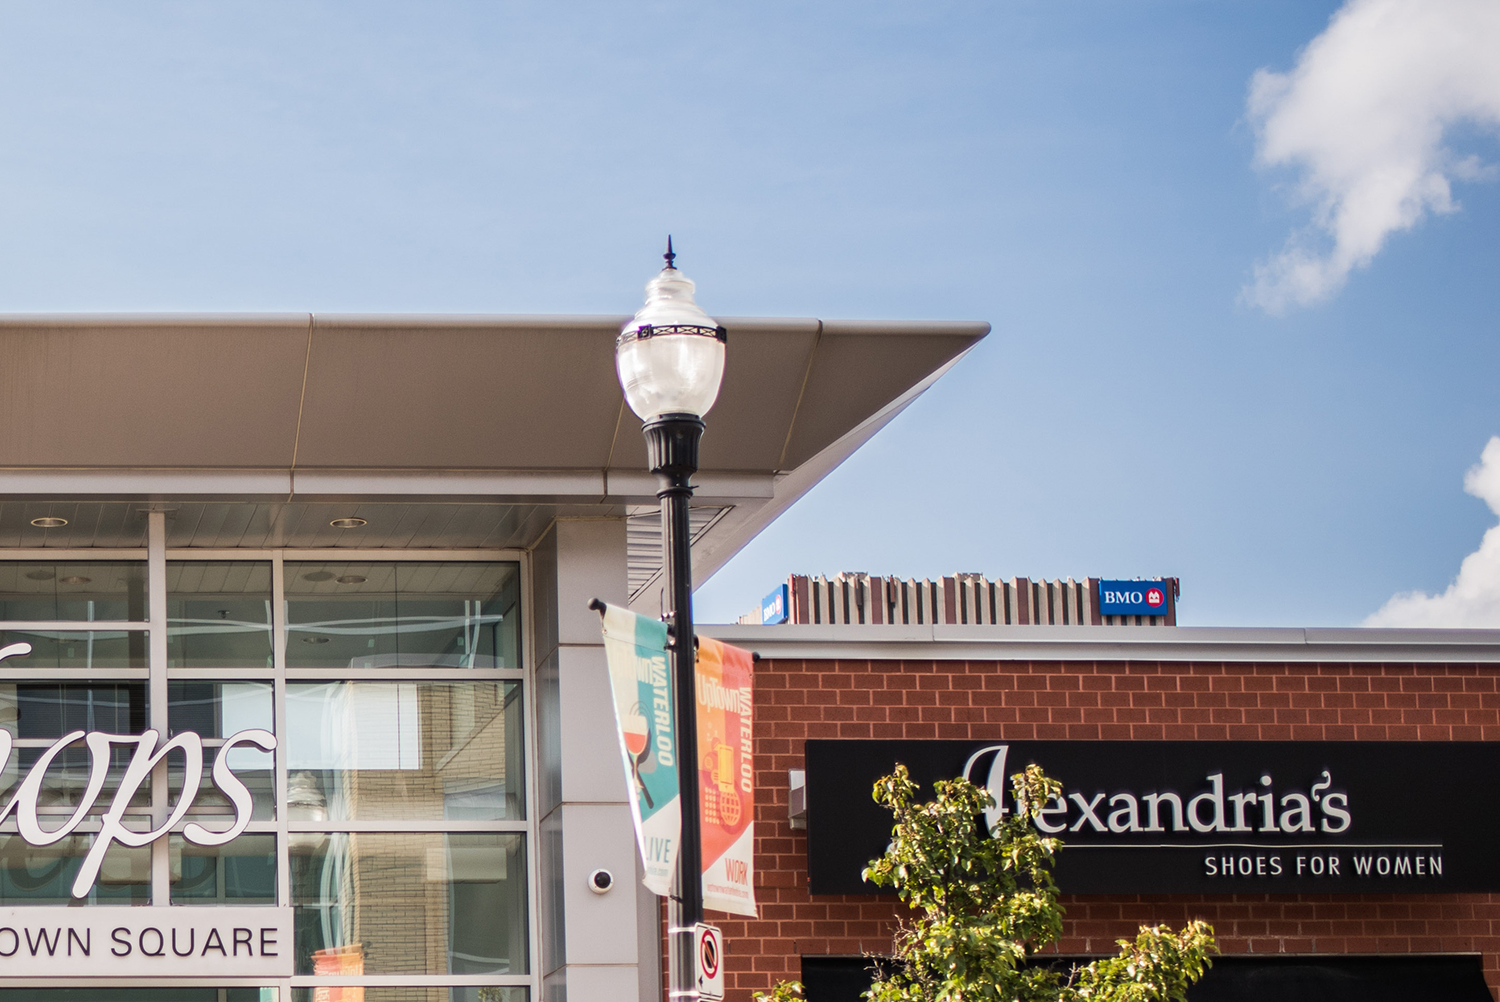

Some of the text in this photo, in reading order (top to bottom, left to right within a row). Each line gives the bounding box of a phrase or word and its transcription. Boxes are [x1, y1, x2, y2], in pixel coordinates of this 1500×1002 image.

[1104, 590, 1143, 604] BMO
[697, 673, 741, 714] UpTown
[651, 656, 674, 767] WATERLOO
[739, 686, 752, 793] WATERLOO
[725, 858, 748, 886] WORK
[1205, 856, 1444, 876] SHOES FOR WOMEN
[110, 927, 279, 957] SQUARE
